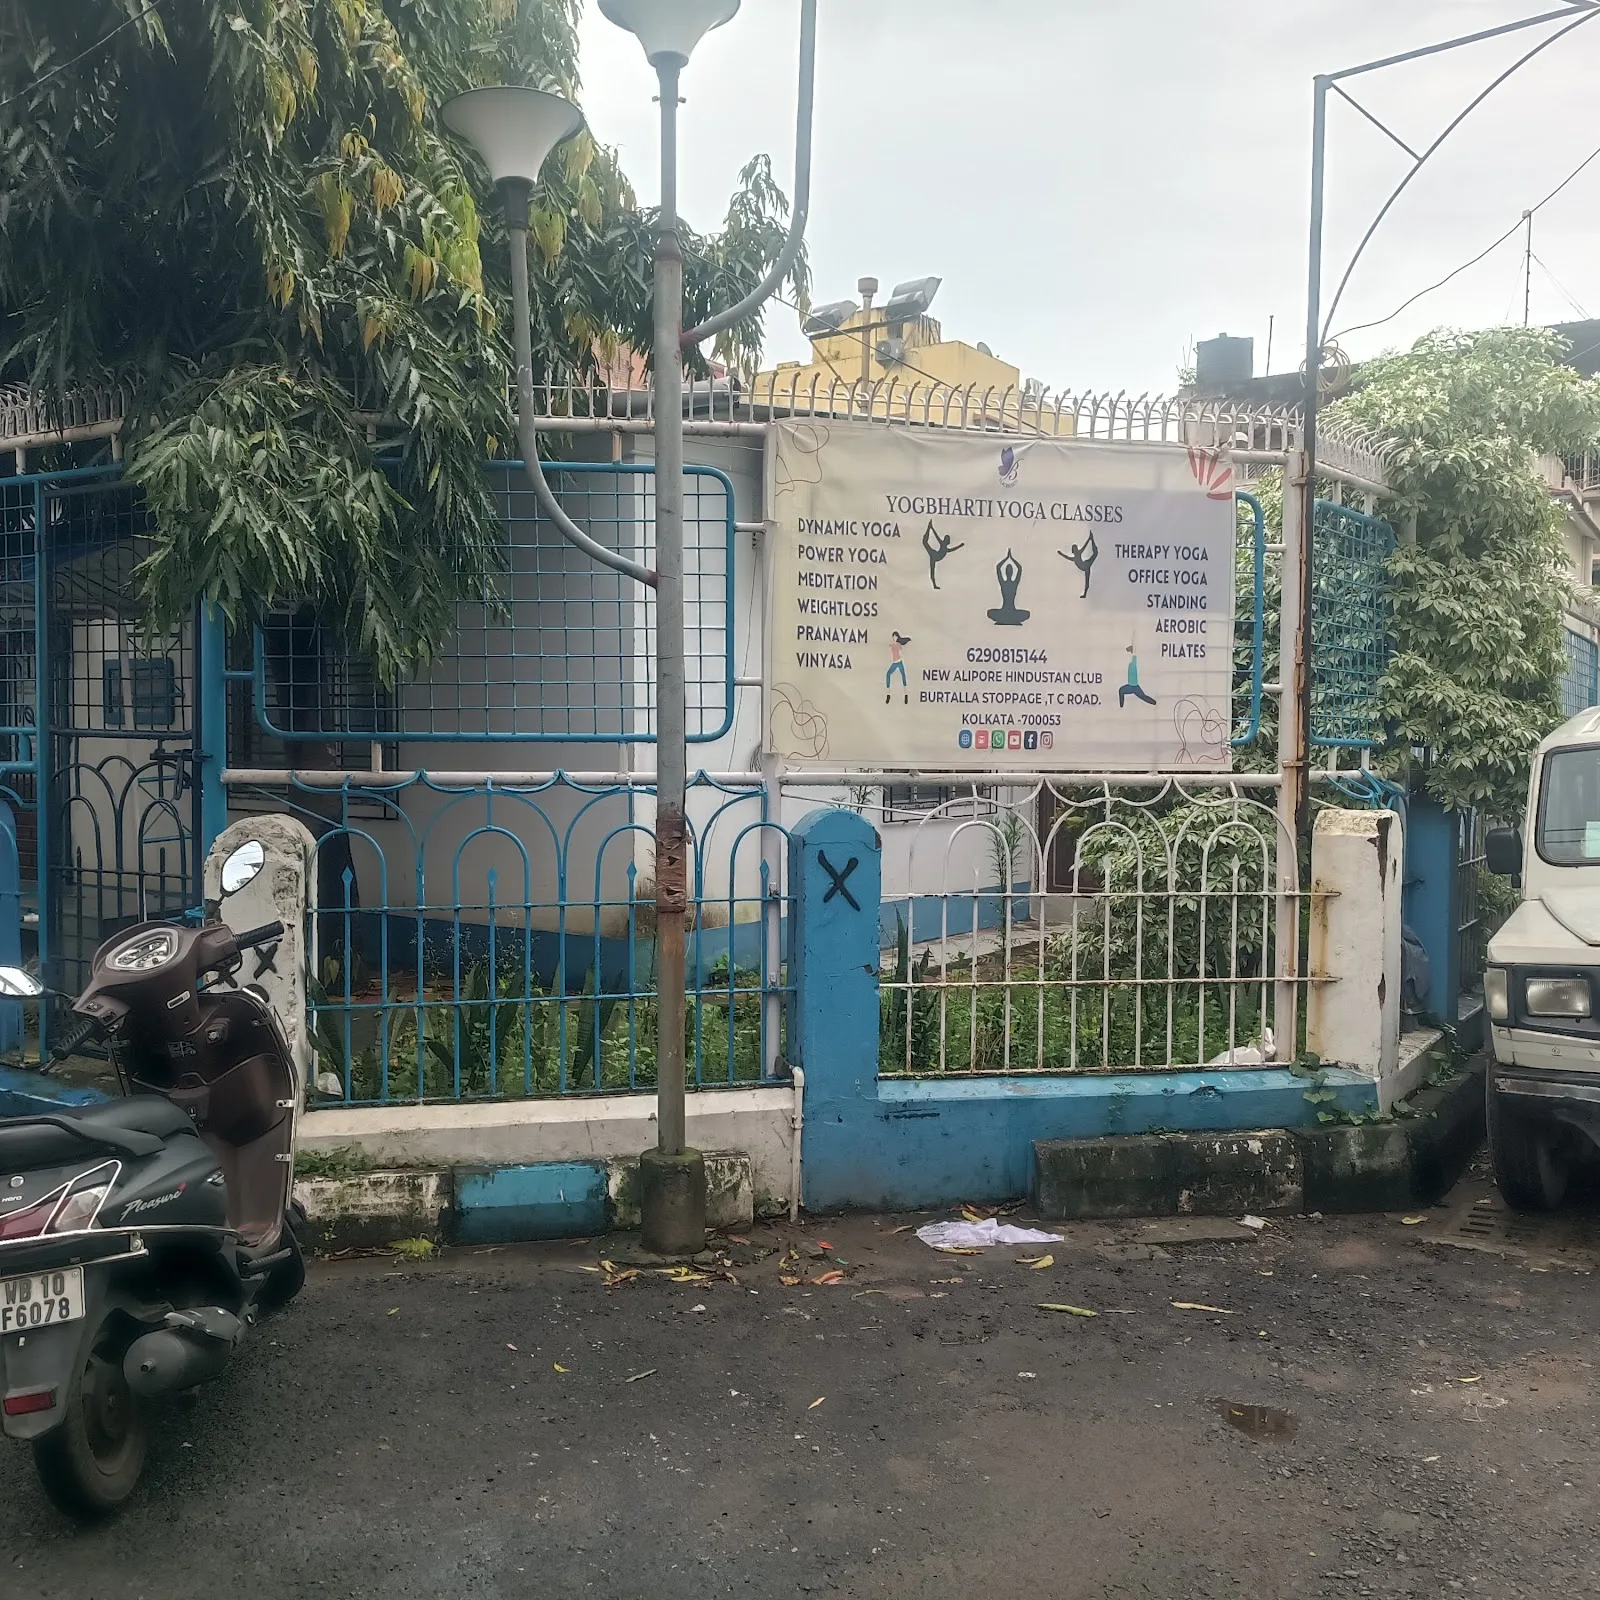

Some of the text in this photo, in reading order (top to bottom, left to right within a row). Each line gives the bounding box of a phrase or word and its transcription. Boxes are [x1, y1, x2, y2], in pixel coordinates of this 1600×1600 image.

[886, 495, 1123, 523] YOGBHARTI YOGA CLASSES
[798, 517, 901, 538] DYNAMIC YOGA
[798, 544, 887, 565] POWER YOGA
[1115, 543, 1209, 561] THERAPY YOGA
[798, 571, 878, 590] MEDITATION
[1128, 569, 1208, 586] OFFICE YOGA
[797, 598, 878, 617] WEIGHTLOSS
[1147, 594, 1207, 610] STANDING
[797, 625, 868, 644] PRANAYAM
[1155, 618, 1207, 634] AEROBIC
[966, 647, 1047, 664] 6290815144
[1161, 643, 1206, 658] PILATES
[796, 652, 852, 670] VINYASA
[922, 669, 1103, 684] NEW ALIPORE HINDUSTAN CLUB
[920, 691, 979, 703] BURTALLA
[982, 692, 1042, 704] STOPPAGE
[1057, 693, 1065, 704] C
[1067, 693, 1102, 705] ROAD.
[961, 713, 1061, 726] KOLKATA -700053
[119, 1189, 183, 1222] Pleasure
[5, 1272, 65, 1304] WB 10
[2, 1297, 70, 1331] F6078
